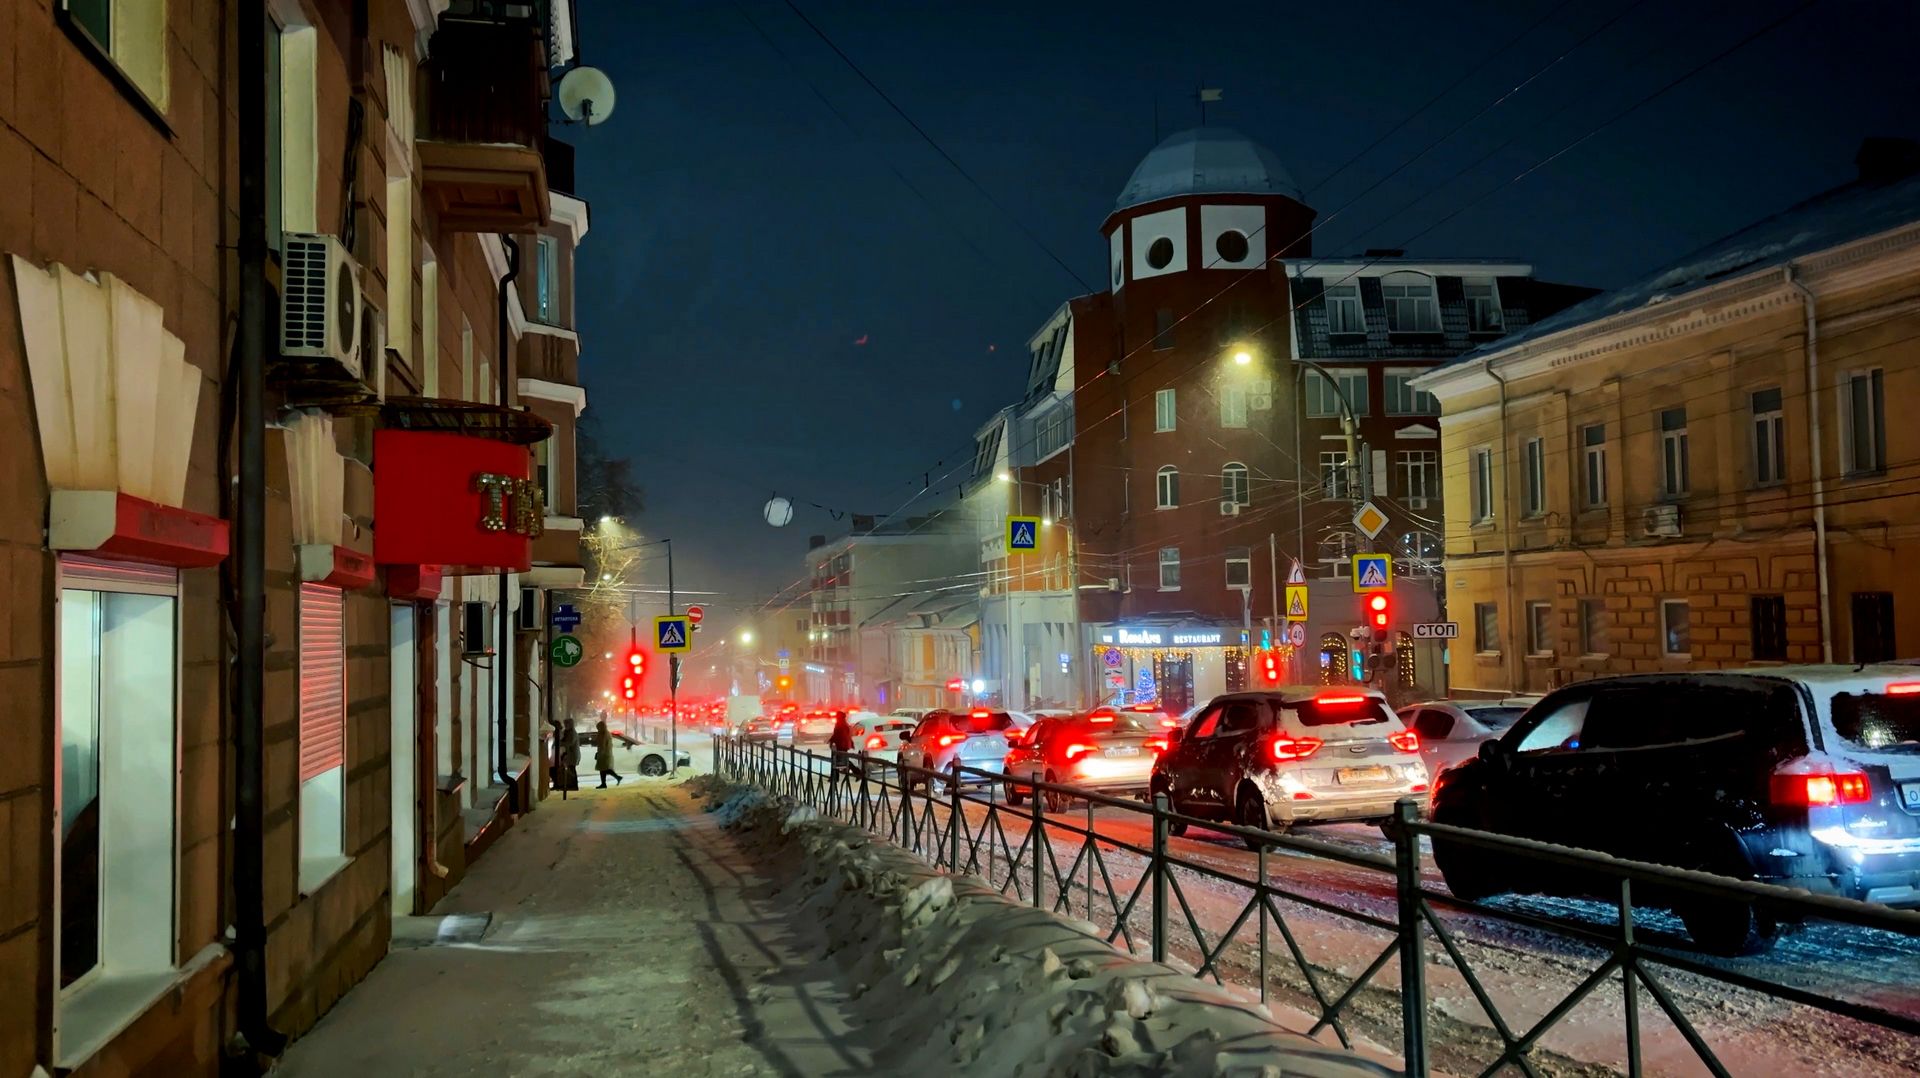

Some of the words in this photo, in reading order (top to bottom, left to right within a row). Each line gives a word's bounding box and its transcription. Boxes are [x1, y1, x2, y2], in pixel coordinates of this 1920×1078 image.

[1293, 630, 1303, 641] 40
[1417, 625, 1455, 636] СТОП
[1173, 635, 1220, 644] RESTAURANT
